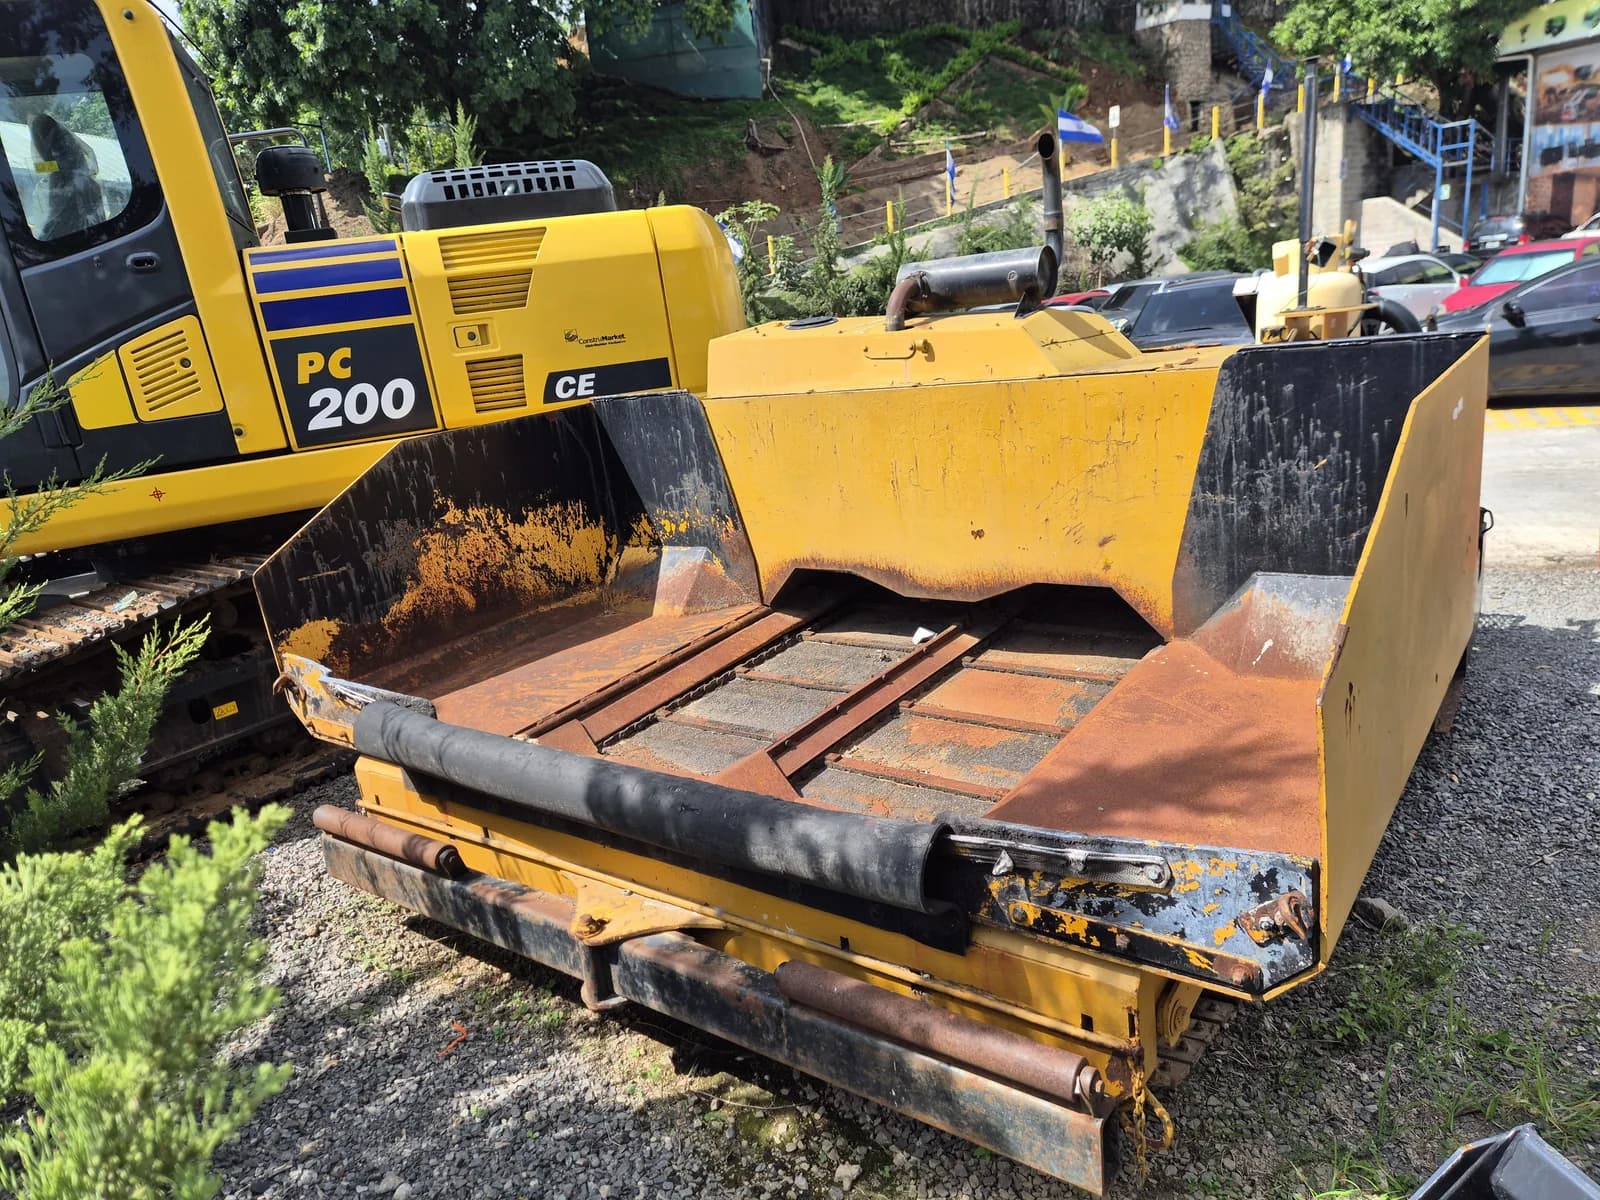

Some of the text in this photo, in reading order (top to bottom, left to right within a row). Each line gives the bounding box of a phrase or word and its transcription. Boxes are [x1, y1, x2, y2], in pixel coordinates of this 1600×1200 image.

[297, 346, 352, 385] PC
[307, 377, 416, 431] 200
[555, 372, 596, 399] CE
